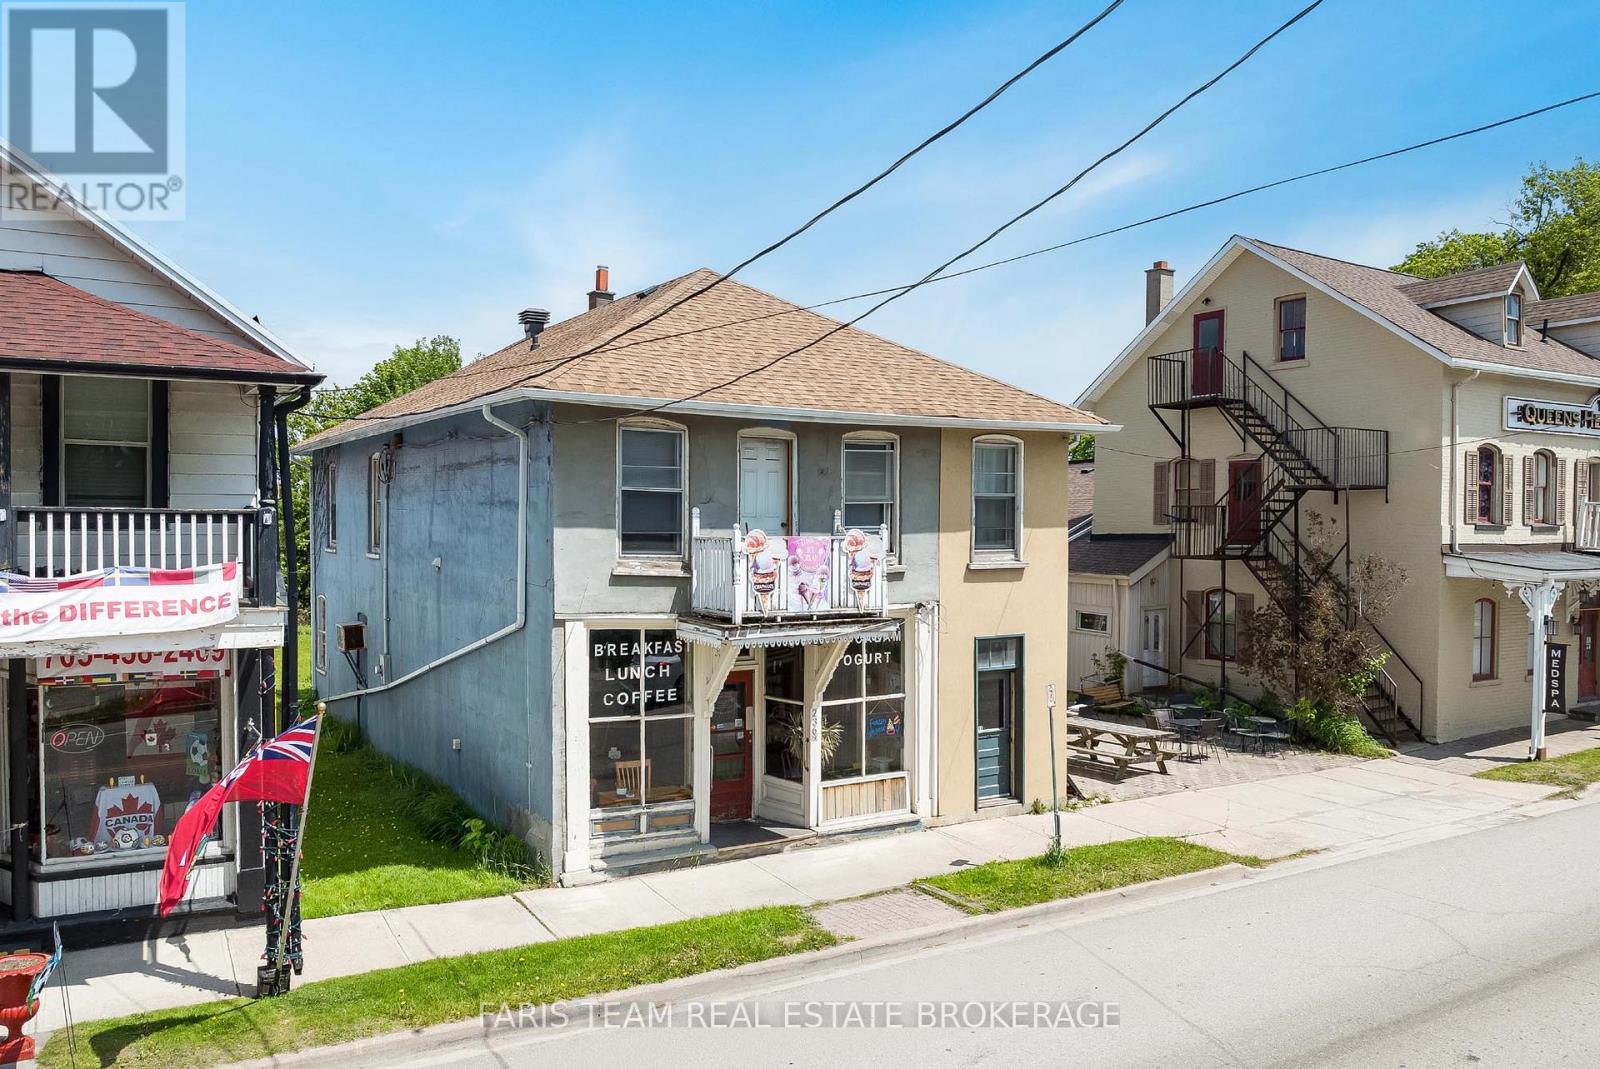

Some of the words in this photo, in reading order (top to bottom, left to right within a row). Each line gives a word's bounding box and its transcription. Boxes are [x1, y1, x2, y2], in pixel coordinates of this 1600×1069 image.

[1522, 403, 1580, 428] QUEENS
[1, 608, 49, 626] the
[59, 592, 232, 622] DIFFERENCE
[843, 651, 892, 666] OGURT
[605, 664, 670, 681] LUNCH
[1551, 649, 1561, 708] MEDSPA
[603, 688, 678, 706] COFFEE
[53, 731, 100, 747] OPEN
[105, 814, 154, 828] CANADA
